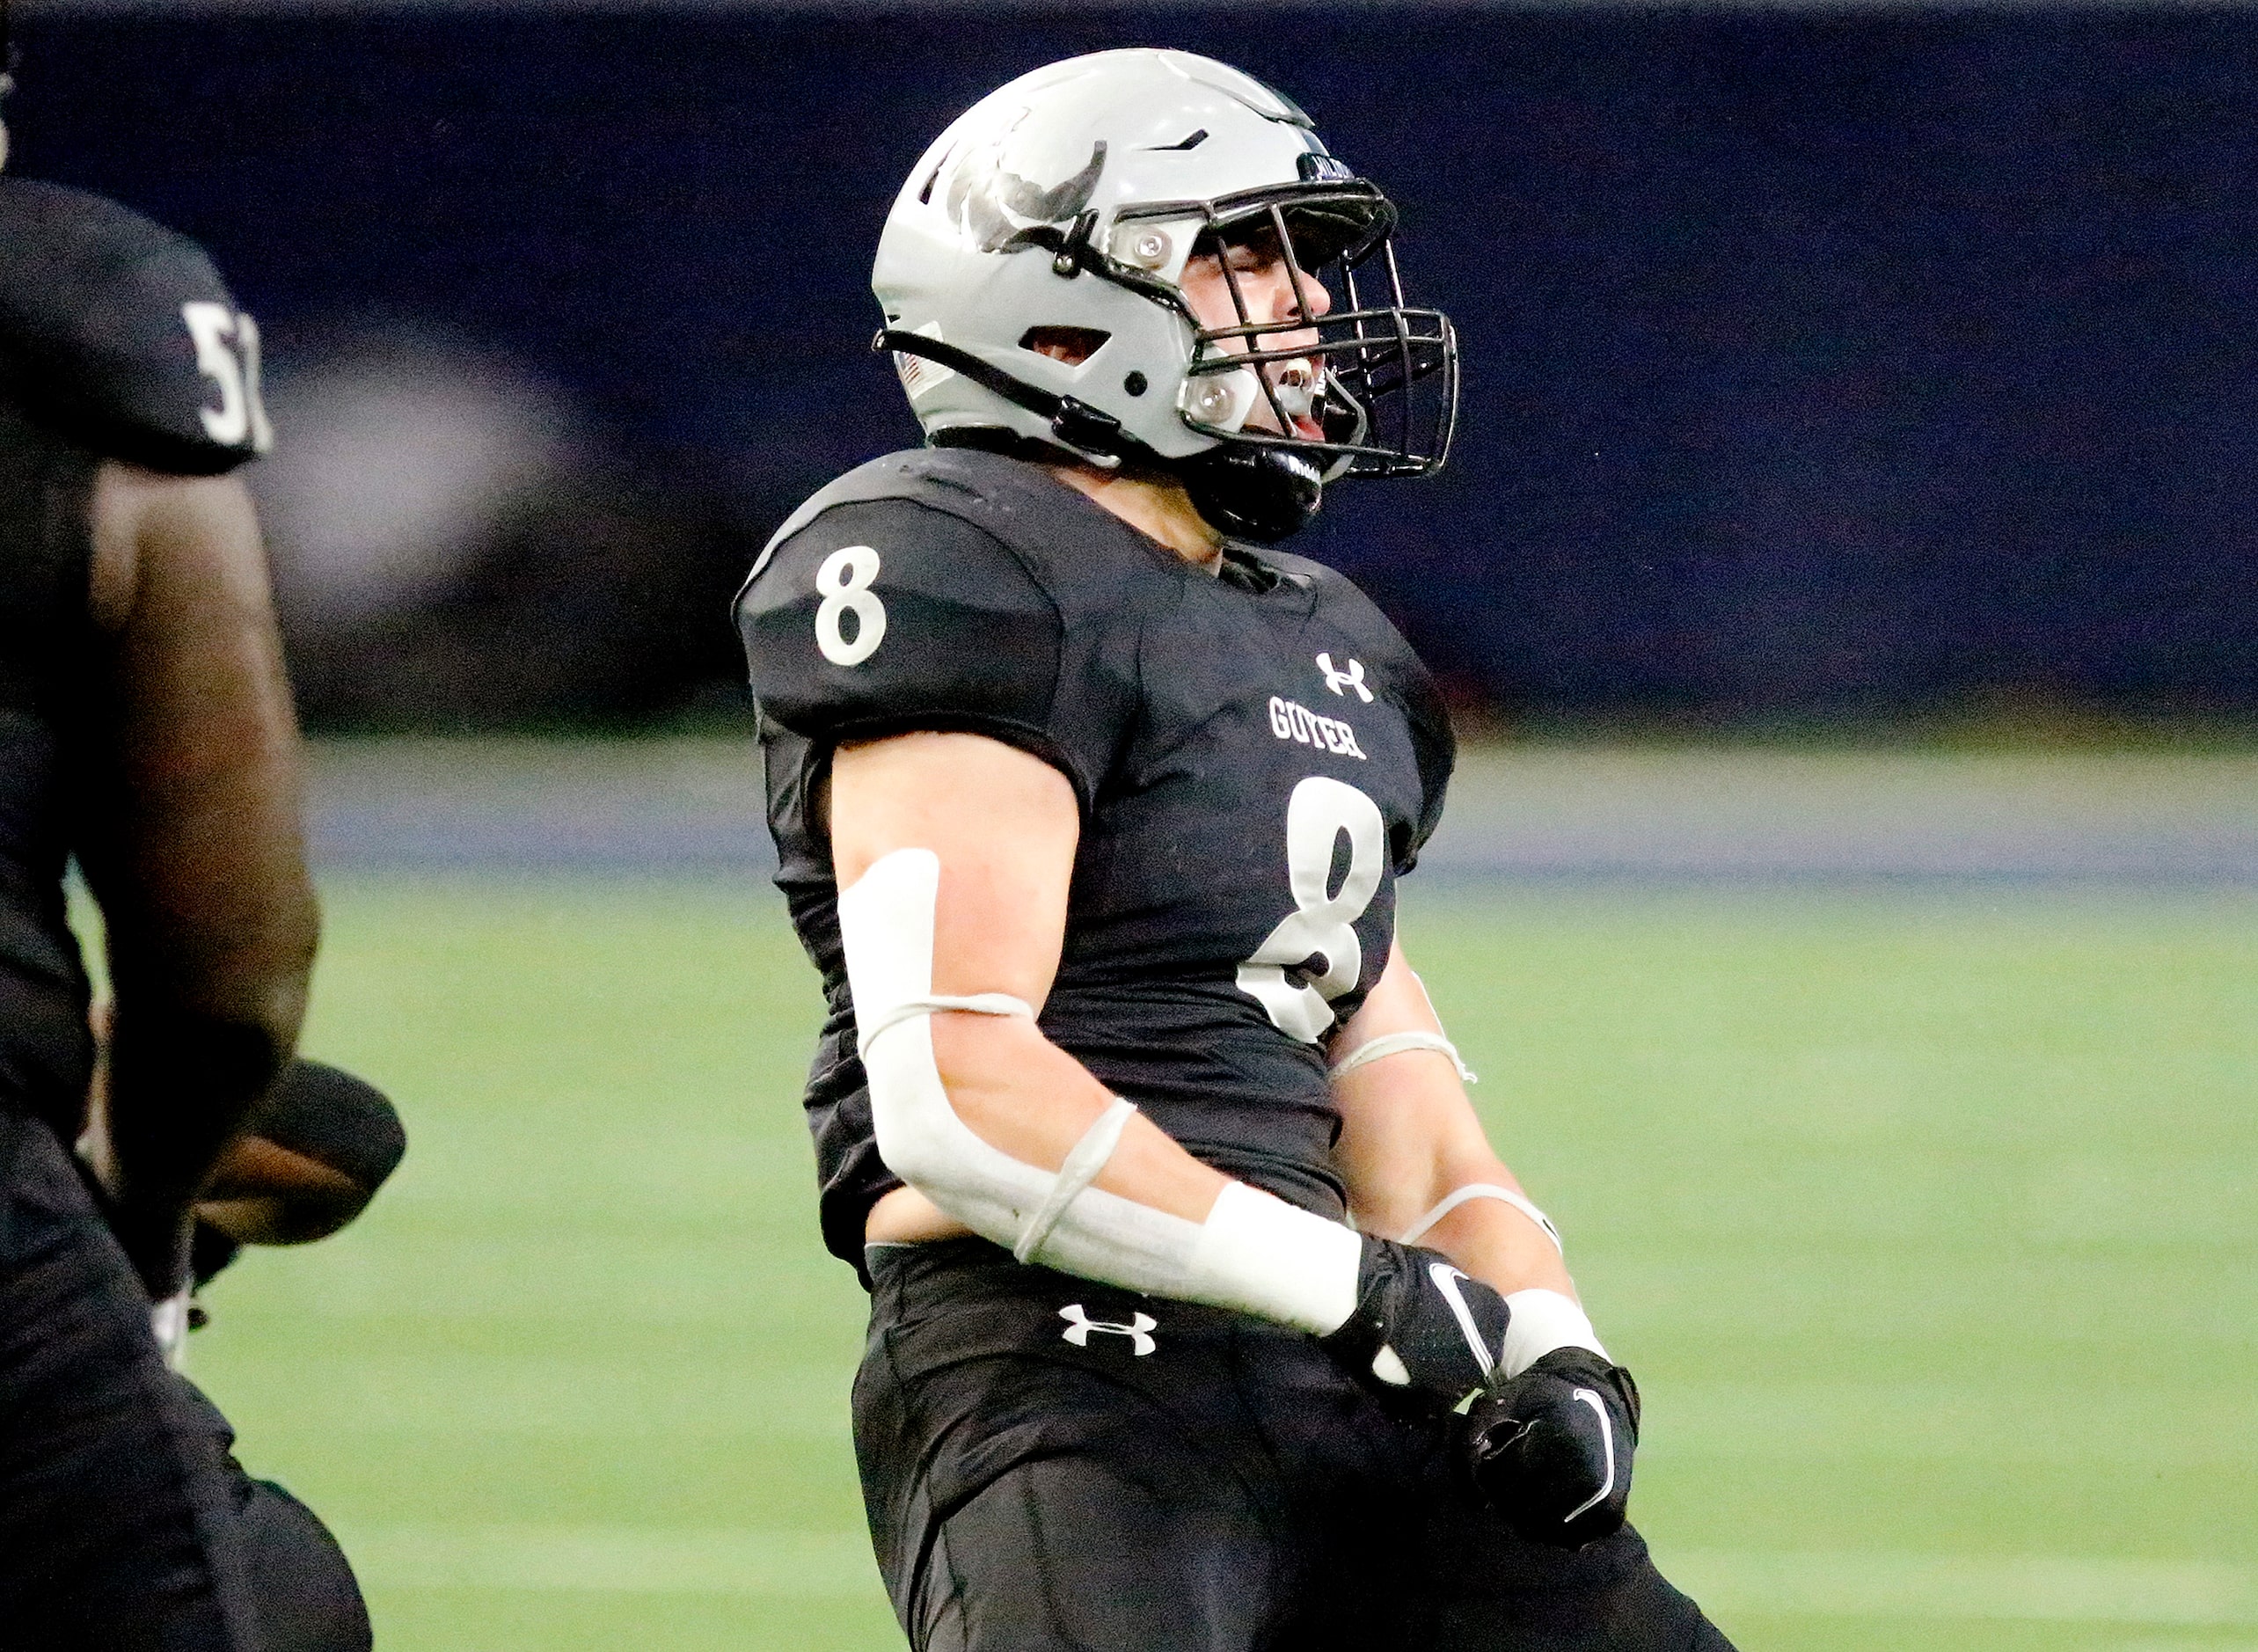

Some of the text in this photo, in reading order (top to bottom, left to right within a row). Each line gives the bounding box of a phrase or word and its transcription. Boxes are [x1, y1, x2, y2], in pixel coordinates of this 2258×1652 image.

[815, 545, 887, 666] 8
[1269, 696, 1367, 759] GUYER
[1235, 776, 1385, 1044] 8
